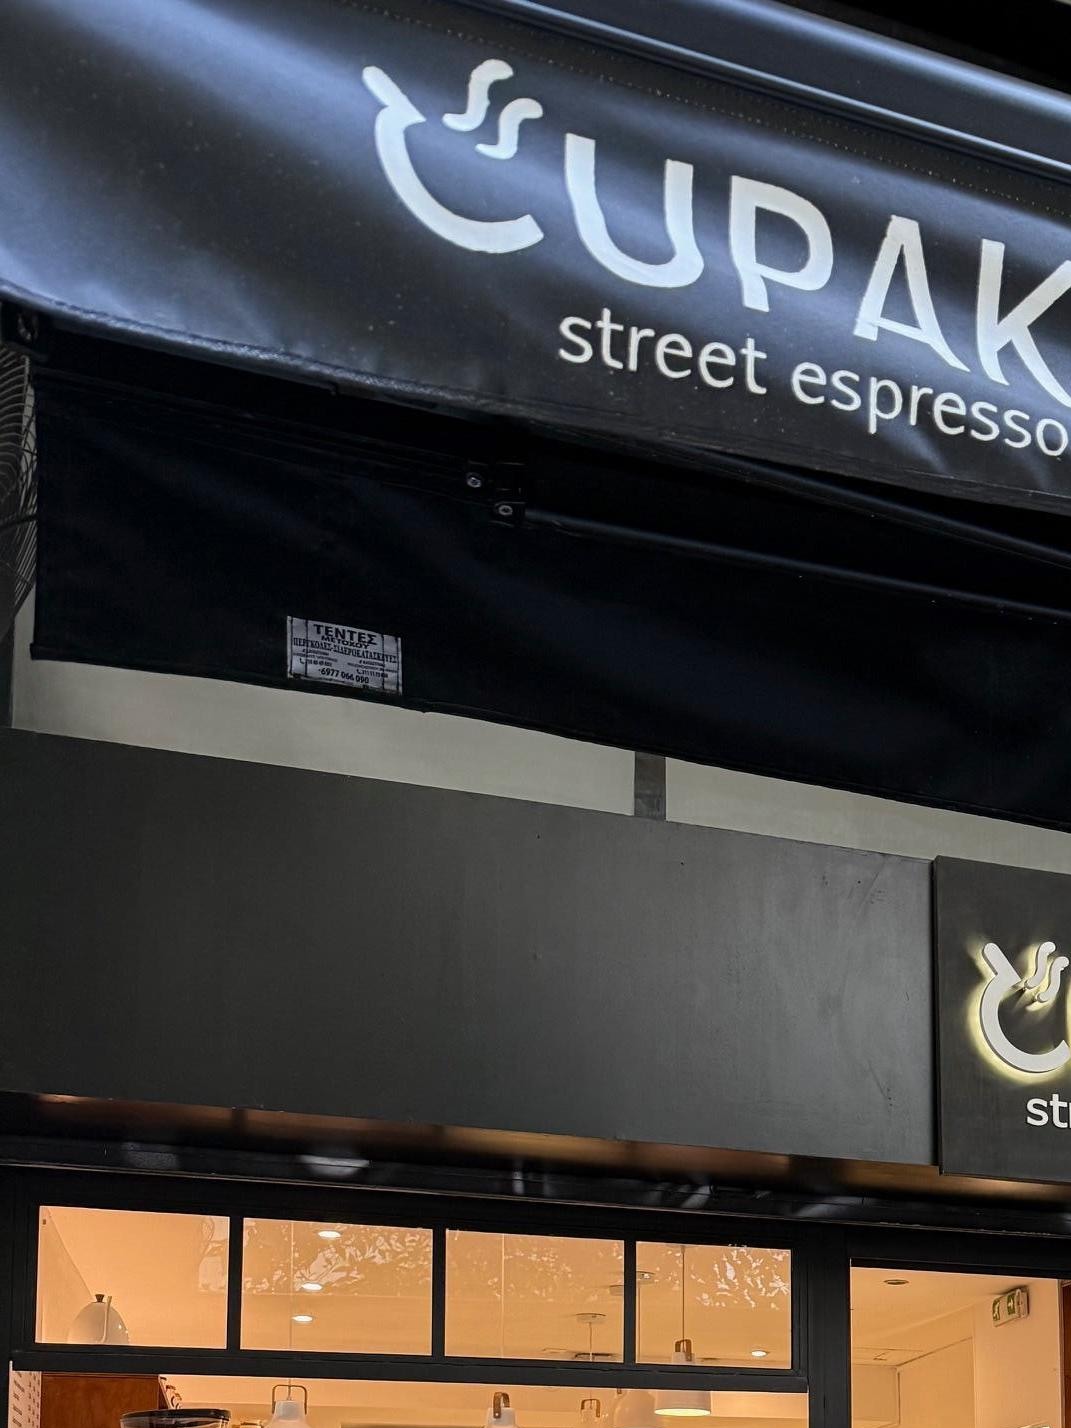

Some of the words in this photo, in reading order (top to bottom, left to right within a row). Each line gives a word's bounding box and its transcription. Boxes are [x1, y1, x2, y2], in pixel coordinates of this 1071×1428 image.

[558, 308, 767, 396] street
[791, 359, 1069, 458] espresso
[313, 624, 378, 645] ΤΕΝΤΕΣ
